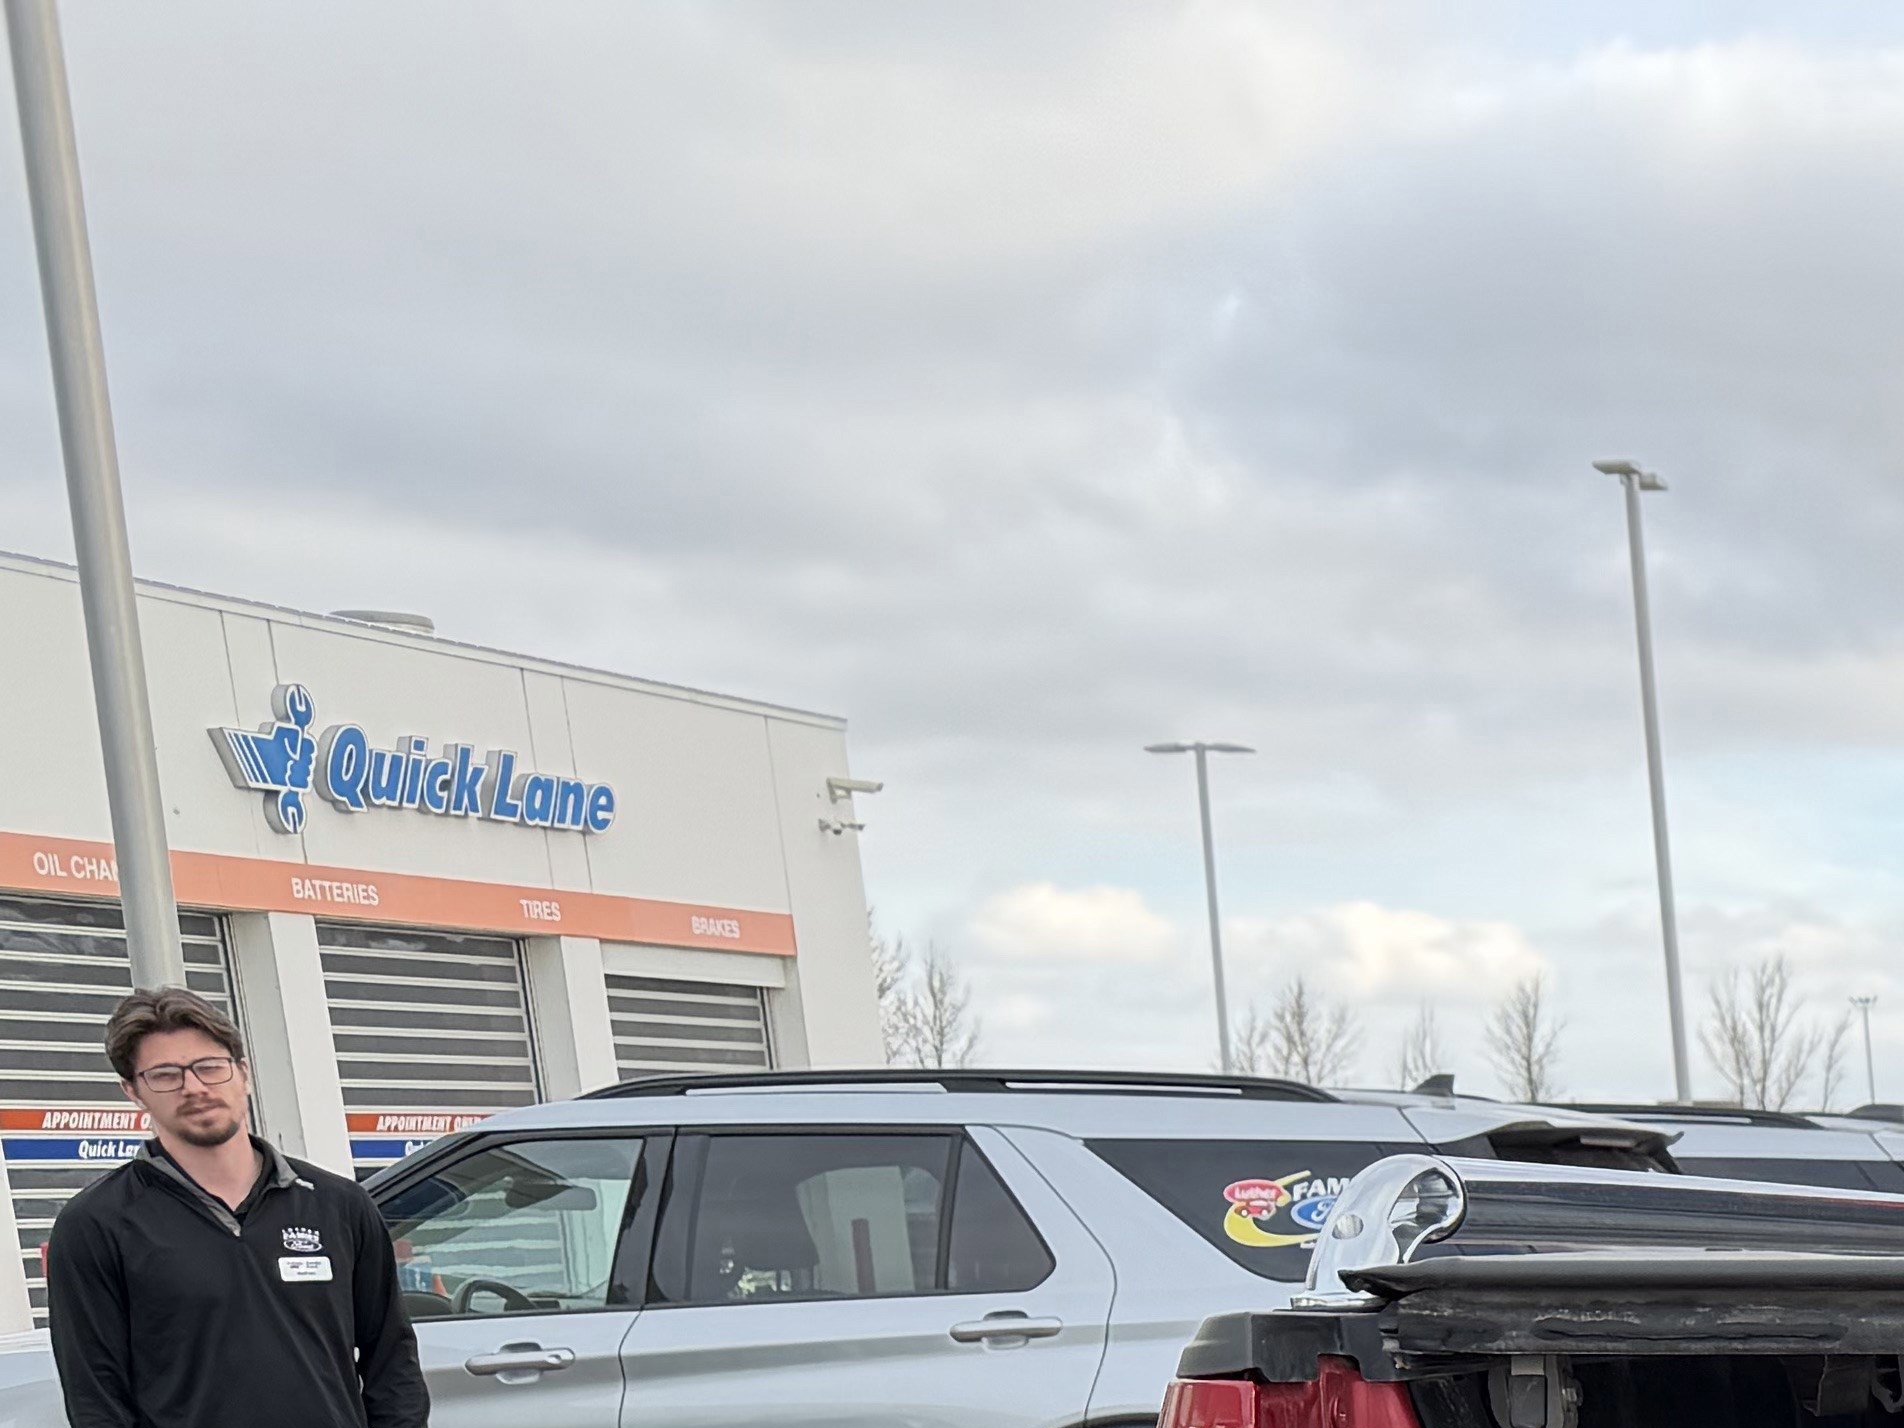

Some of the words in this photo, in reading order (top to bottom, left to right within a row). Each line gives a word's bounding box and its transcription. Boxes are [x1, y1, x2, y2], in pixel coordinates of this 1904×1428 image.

[326, 724, 488, 817] Quick
[490, 749, 616, 834] Lane
[33, 851, 67, 877] OIL
[292, 877, 379, 907] BATTERIES
[519, 899, 561, 922] TIRES
[691, 915, 741, 939] BRAKES
[41, 1111, 138, 1130] APPOINTMENT
[376, 1115, 452, 1132] APPOINTMENT
[78, 1140, 116, 1159] Quick
[1293, 1177, 1350, 1202] FAM
